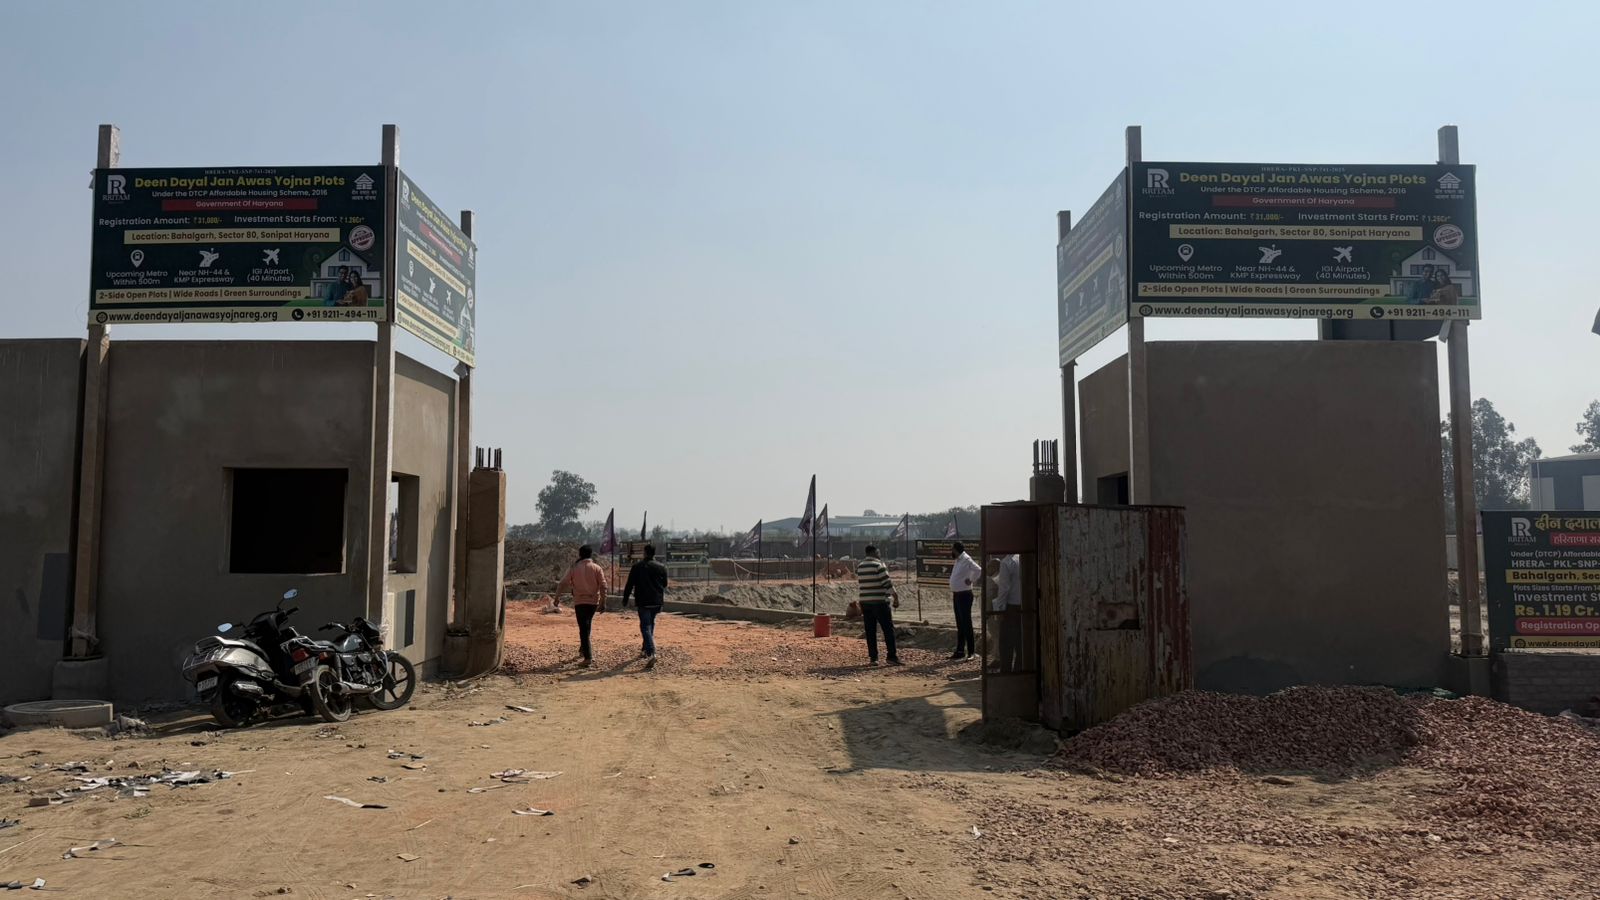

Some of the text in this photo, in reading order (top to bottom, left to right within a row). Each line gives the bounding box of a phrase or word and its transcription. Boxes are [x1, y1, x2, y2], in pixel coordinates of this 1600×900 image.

[134, 175, 346, 190] Deen Dayal Jan Awas Yojna Plots
[1179, 172, 1427, 187] Deen Dayal Jan Awas Yojna Plots
[151, 188, 328, 198] Under the DTCP Affordable Housing Scheme, 2016
[1267, 186, 1312, 194] Affordable
[1313, 186, 1348, 196] Housing
[1349, 187, 1387, 195] Scheme,
[195, 200, 241, 208] Government
[253, 200, 284, 208] Haryana
[1251, 197, 1355, 207] Government Of Haryana
[234, 215, 283, 223] Investment
[285, 215, 312, 223] Starts
[313, 215, 337, 223] From:
[1138, 211, 1200, 221] Registration
[1203, 211, 1247, 220] Amount:
[1298, 212, 1356, 221] Investment
[1357, 212, 1388, 221] Starts
[1390, 212, 1419, 222] From:
[99, 217, 152, 228] Registration
[153, 217, 191, 225] Amount:
[131, 230, 330, 242] Location: Bahalgarh, Sector 80, Sonipat Haryana
[1178, 226, 1411, 239] Location: Bahalgarh, Sector 80, Sonipat Haryana
[197, 268, 223, 276] NH-44
[252, 267, 289, 277] IGI Airport
[1149, 264, 1196, 273] Upcoming
[1258, 265, 1287, 273] NH-44
[1288, 265, 1295, 273] &
[1321, 265, 1365, 274] IGI Airport
[105, 270, 145, 279] Upcoming
[246, 273, 295, 283] (40 Minutes)
[1158, 272, 1214, 280] Within 500m
[1250, 272, 1301, 281] Expressway
[1315, 272, 1371, 281] (40 Minutes)
[112, 278, 137, 286] Within
[190, 275, 235, 285] Expressway
[99, 291, 125, 299] 2-Side
[126, 291, 148, 300] Open
[148, 290, 168, 299] Plots
[173, 290, 193, 298] Wide
[194, 289, 219, 298] Roads
[223, 288, 248, 297] Green
[248, 288, 302, 298] Surroundings
[1142, 285, 1173, 293] 2-Side
[1173, 285, 1200, 294] Open
[1200, 285, 1224, 293] Plots
[1230, 285, 1252, 294] Wide
[1254, 285, 1283, 294] Roads
[1289, 286, 1317, 294] Green
[1318, 286, 1380, 296] Surroundings
[108, 310, 278, 322] www.deendayaljanawasyojnareg.org
[306, 310, 378, 319] +91 9211-494-111
[1155, 305, 1354, 317] www.deendayaljanawasyojnareg.org
[1387, 308, 1470, 317] +91 9211-494-111
[1533, 513, 1561, 531] दीन
[1534, 550, 1561, 558] (DTCP)
[1511, 560, 1551, 568] HRERA-
[1512, 571, 1580, 582] Bahalgarh,
[1513, 592, 1587, 602] Investment
[1514, 604, 1599, 616] Rs. 1.19 Cr.
[1521, 621, 1583, 631] Registration
